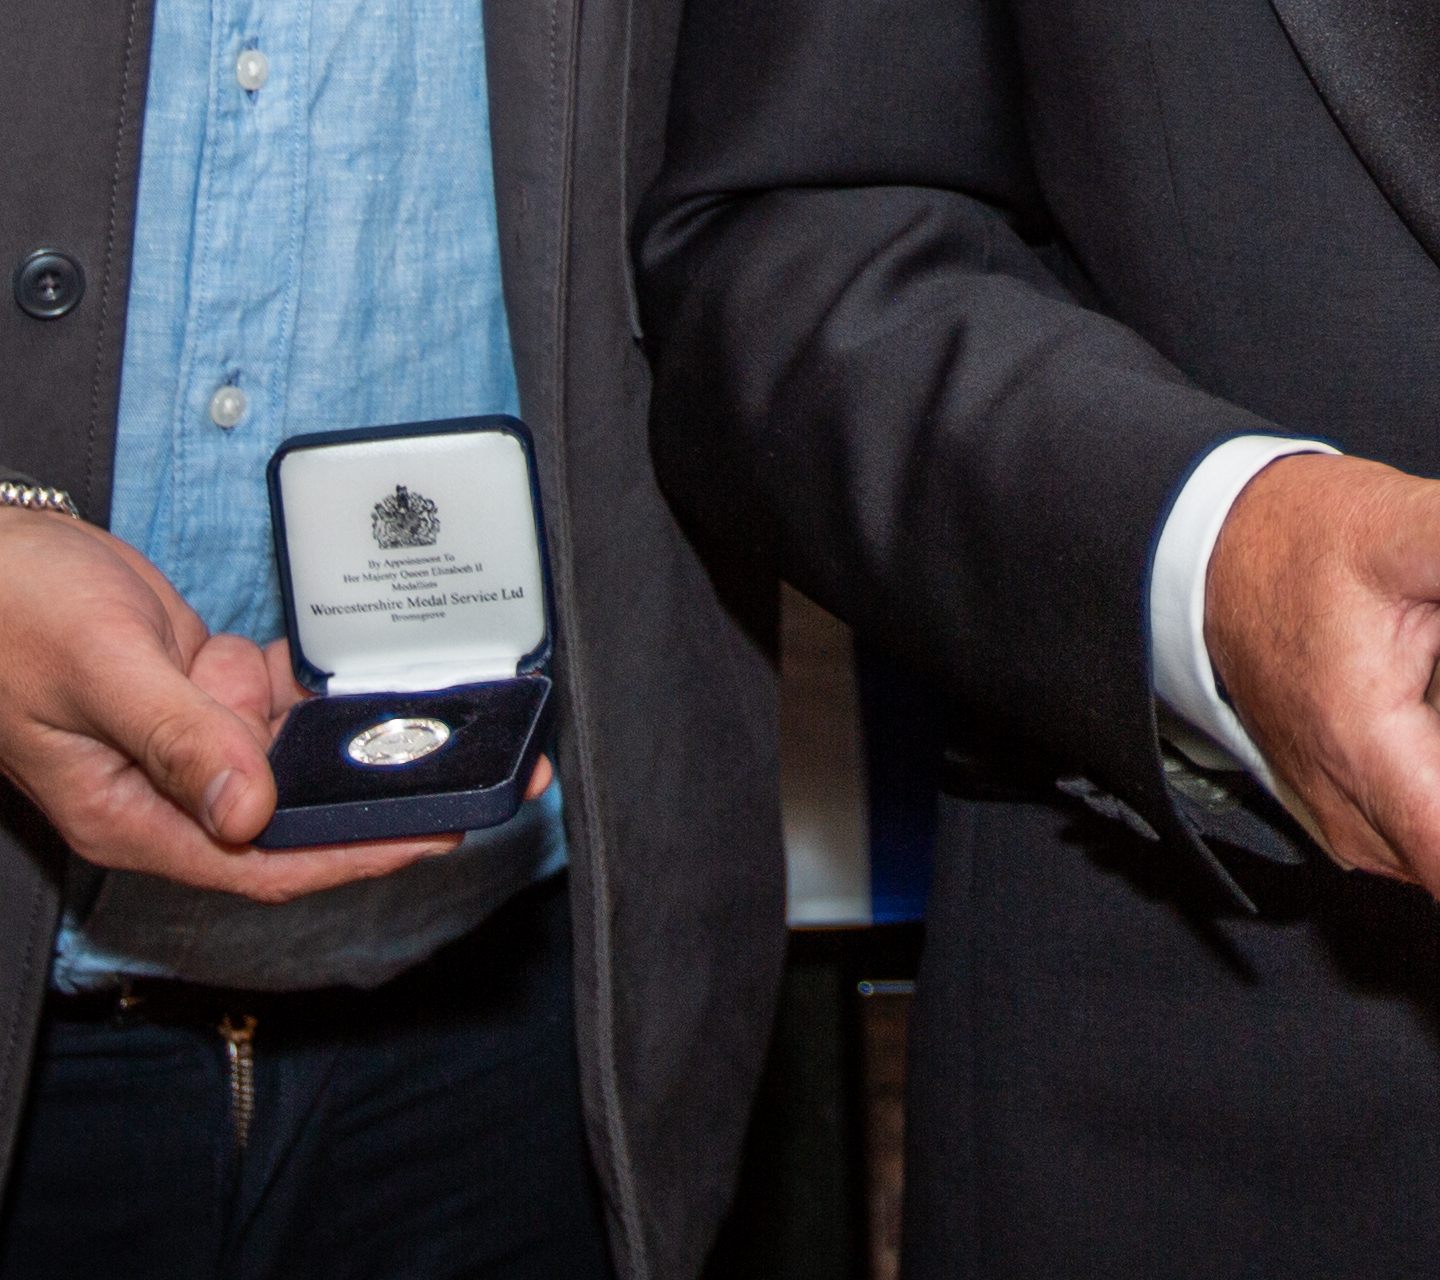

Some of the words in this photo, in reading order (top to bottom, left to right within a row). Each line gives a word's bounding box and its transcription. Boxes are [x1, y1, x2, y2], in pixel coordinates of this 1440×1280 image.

[368, 560, 381, 570] By
[383, 554, 441, 568] Appointment
[444, 553, 456, 562] To
[343, 574, 360, 583] Her
[363, 570, 397, 582] Majesty
[400, 568, 429, 579] Queen
[431, 564, 473, 576] Elizabeth
[475, 563, 483, 572] II
[391, 581, 438, 592] Medallists
[310, 598, 403, 616] Worcestershire
[407, 593, 447, 608] Medal
[450, 589, 498, 605] Service
[501, 586, 525, 599] Ltd
[391, 610, 446, 623] Bromsgrove
